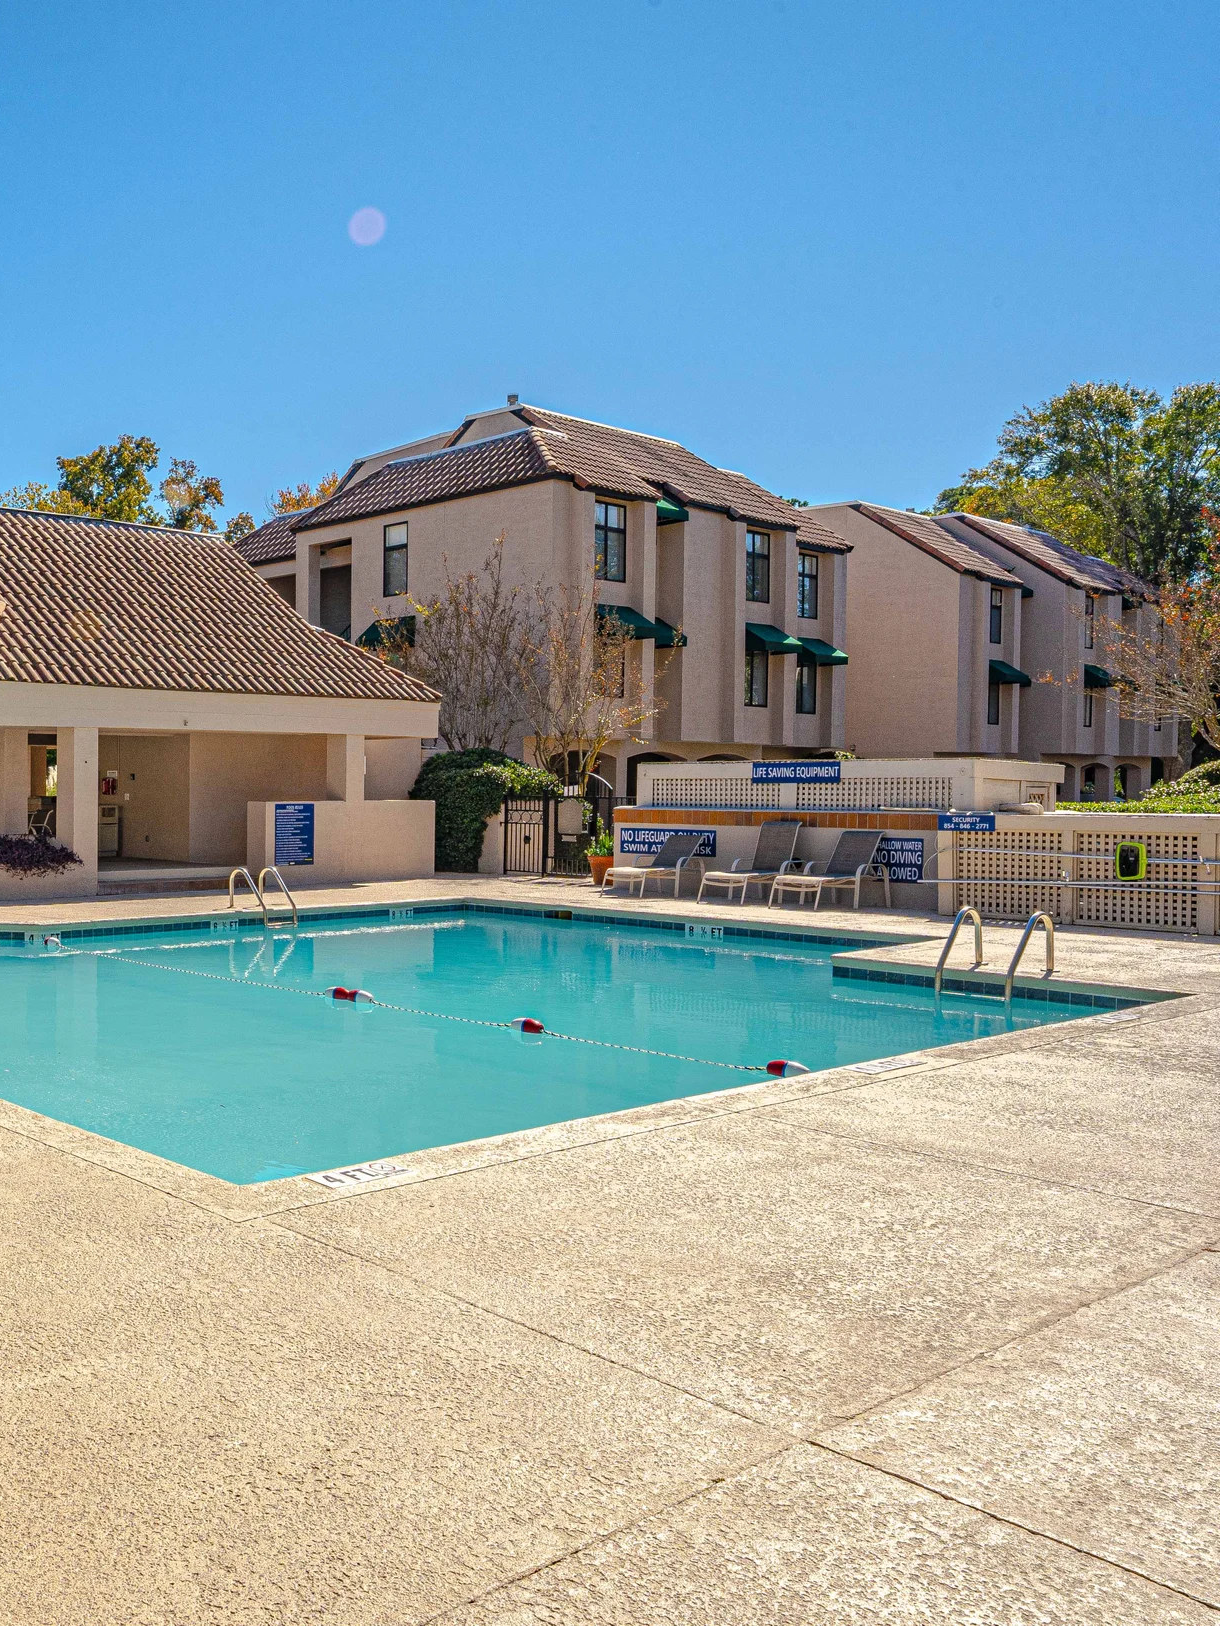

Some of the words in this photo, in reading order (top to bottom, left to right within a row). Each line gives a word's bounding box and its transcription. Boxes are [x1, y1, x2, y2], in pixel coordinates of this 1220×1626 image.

[753, 767, 766, 778] LIFE
[768, 767, 794, 778] SAVING
[796, 766, 840, 778] EQUIPMENT
[621, 830, 634, 841] NO
[623, 843, 648, 852] SWIM
[650, 844, 662, 852] AT
[694, 846, 712, 855] ISK
[877, 840, 902, 850] HALLOW
[902, 841, 922, 850] WATER
[874, 850, 888, 863] NO
[890, 851, 922, 864] DIVING
[877, 866, 919, 880] ALOWED
[322, 1175, 345, 1183] 4
